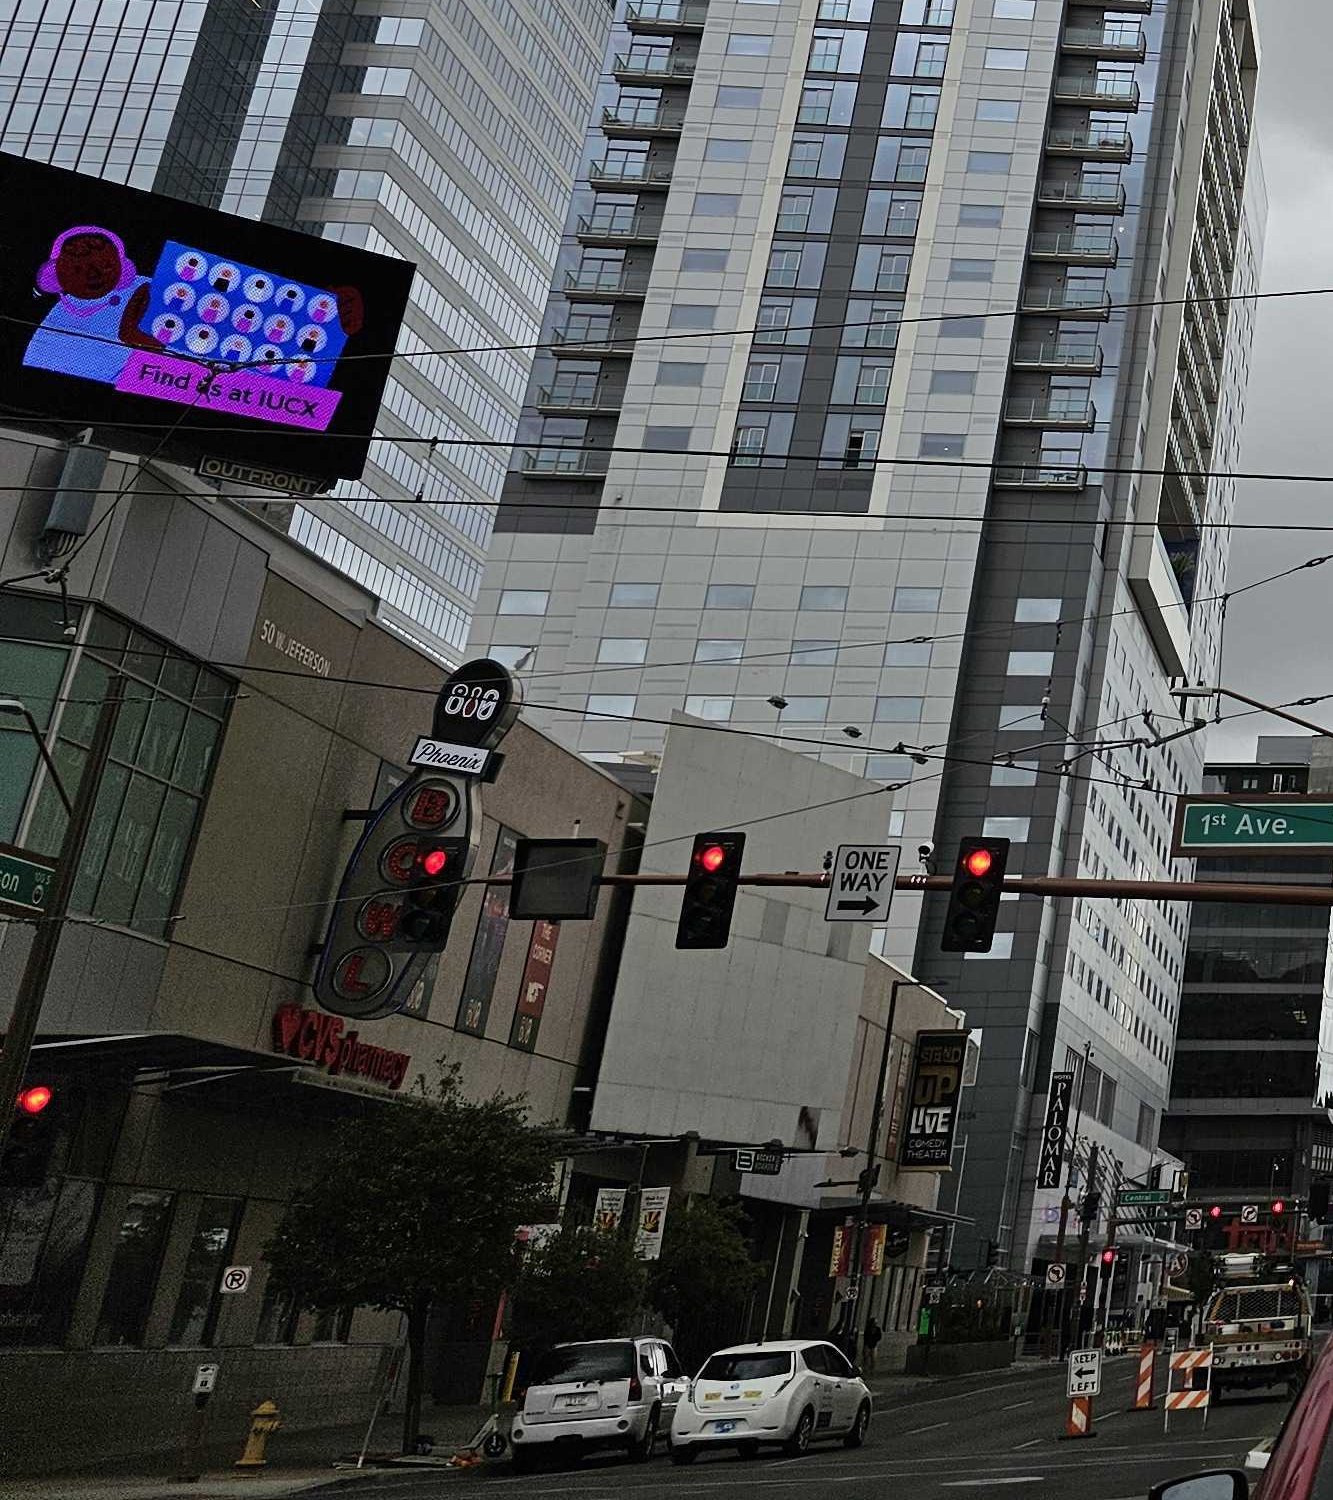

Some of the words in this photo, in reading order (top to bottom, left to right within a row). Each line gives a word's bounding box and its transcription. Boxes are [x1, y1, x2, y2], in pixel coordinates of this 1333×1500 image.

[139, 364, 190, 391] Find
[228, 387, 252, 405] at
[259, 389, 318, 418] IUCX
[205, 459, 317, 494] OUTFRONT
[260, 619, 276, 645] 50
[284, 638, 332, 678] JEFFERSON
[415, 742, 481, 770] Phoenix
[1201, 813, 1227, 835] 1st
[1235, 814, 1296, 835] Ave.
[845, 850, 890, 870] ONE
[0, 870, 20, 893] on
[840, 872, 888, 892] WAY
[299, 1009, 345, 1069] CVS
[337, 1031, 412, 1090] pharmacy
[913, 1064, 959, 1106] UP
[910, 1106, 953, 1134] LIVE
[908, 1138, 946, 1150] COMEDY
[1043, 1082, 1067, 1187] PALOMAR
[906, 1149, 948, 1160] THEATER
[1125, 1193, 1150, 1202] Central
[1073, 1353, 1097, 1365] KEEP
[1071, 1381, 1097, 1392] LEFT
